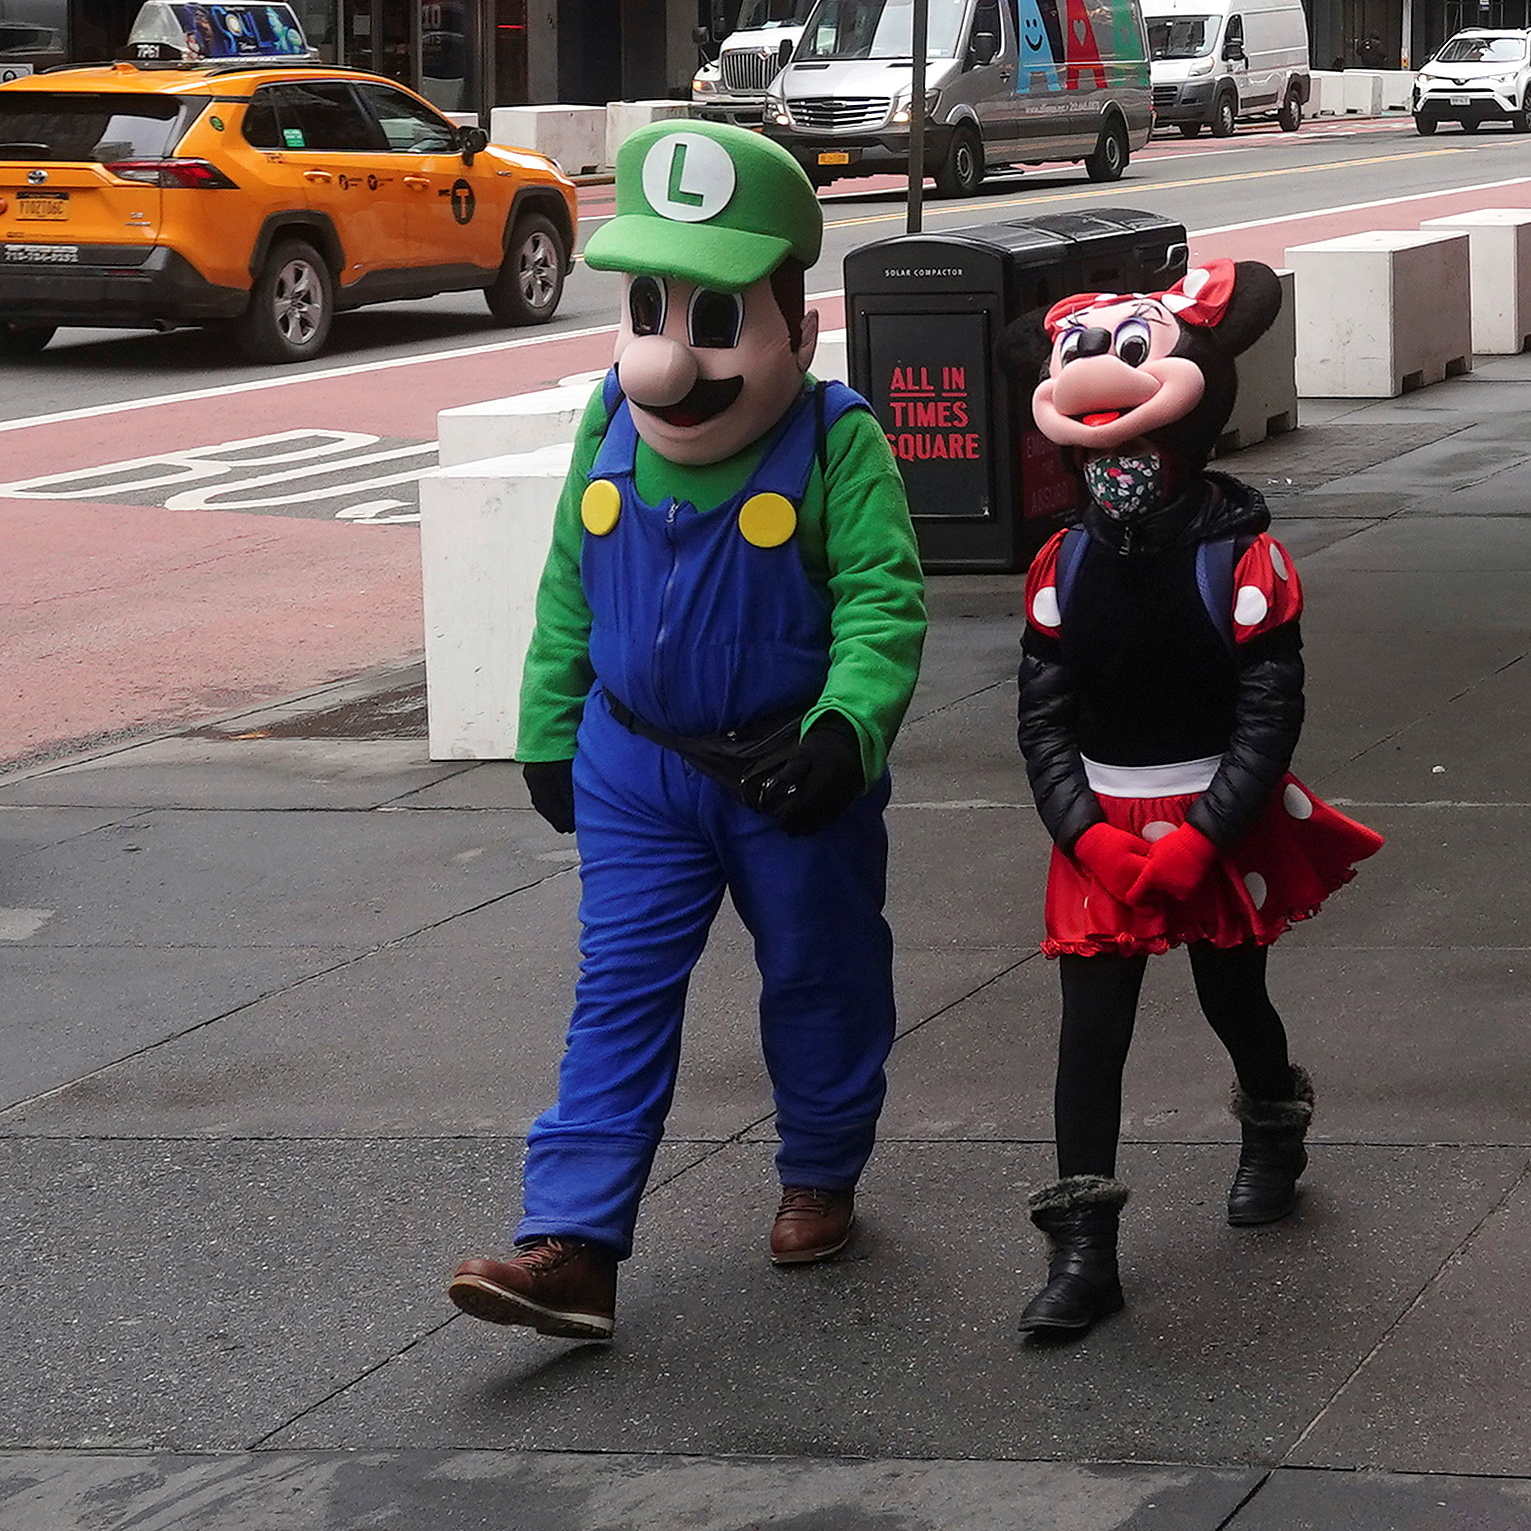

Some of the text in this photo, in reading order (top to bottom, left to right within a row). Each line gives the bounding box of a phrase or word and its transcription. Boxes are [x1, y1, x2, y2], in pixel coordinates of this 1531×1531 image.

[667, 143, 705, 207] L
[884, 268, 963, 277] SOLAR COMPACTOR
[889, 367, 965, 390] ALL IN
[889, 401, 969, 427] TIMES
[884, 433, 980, 462] SQUARE
